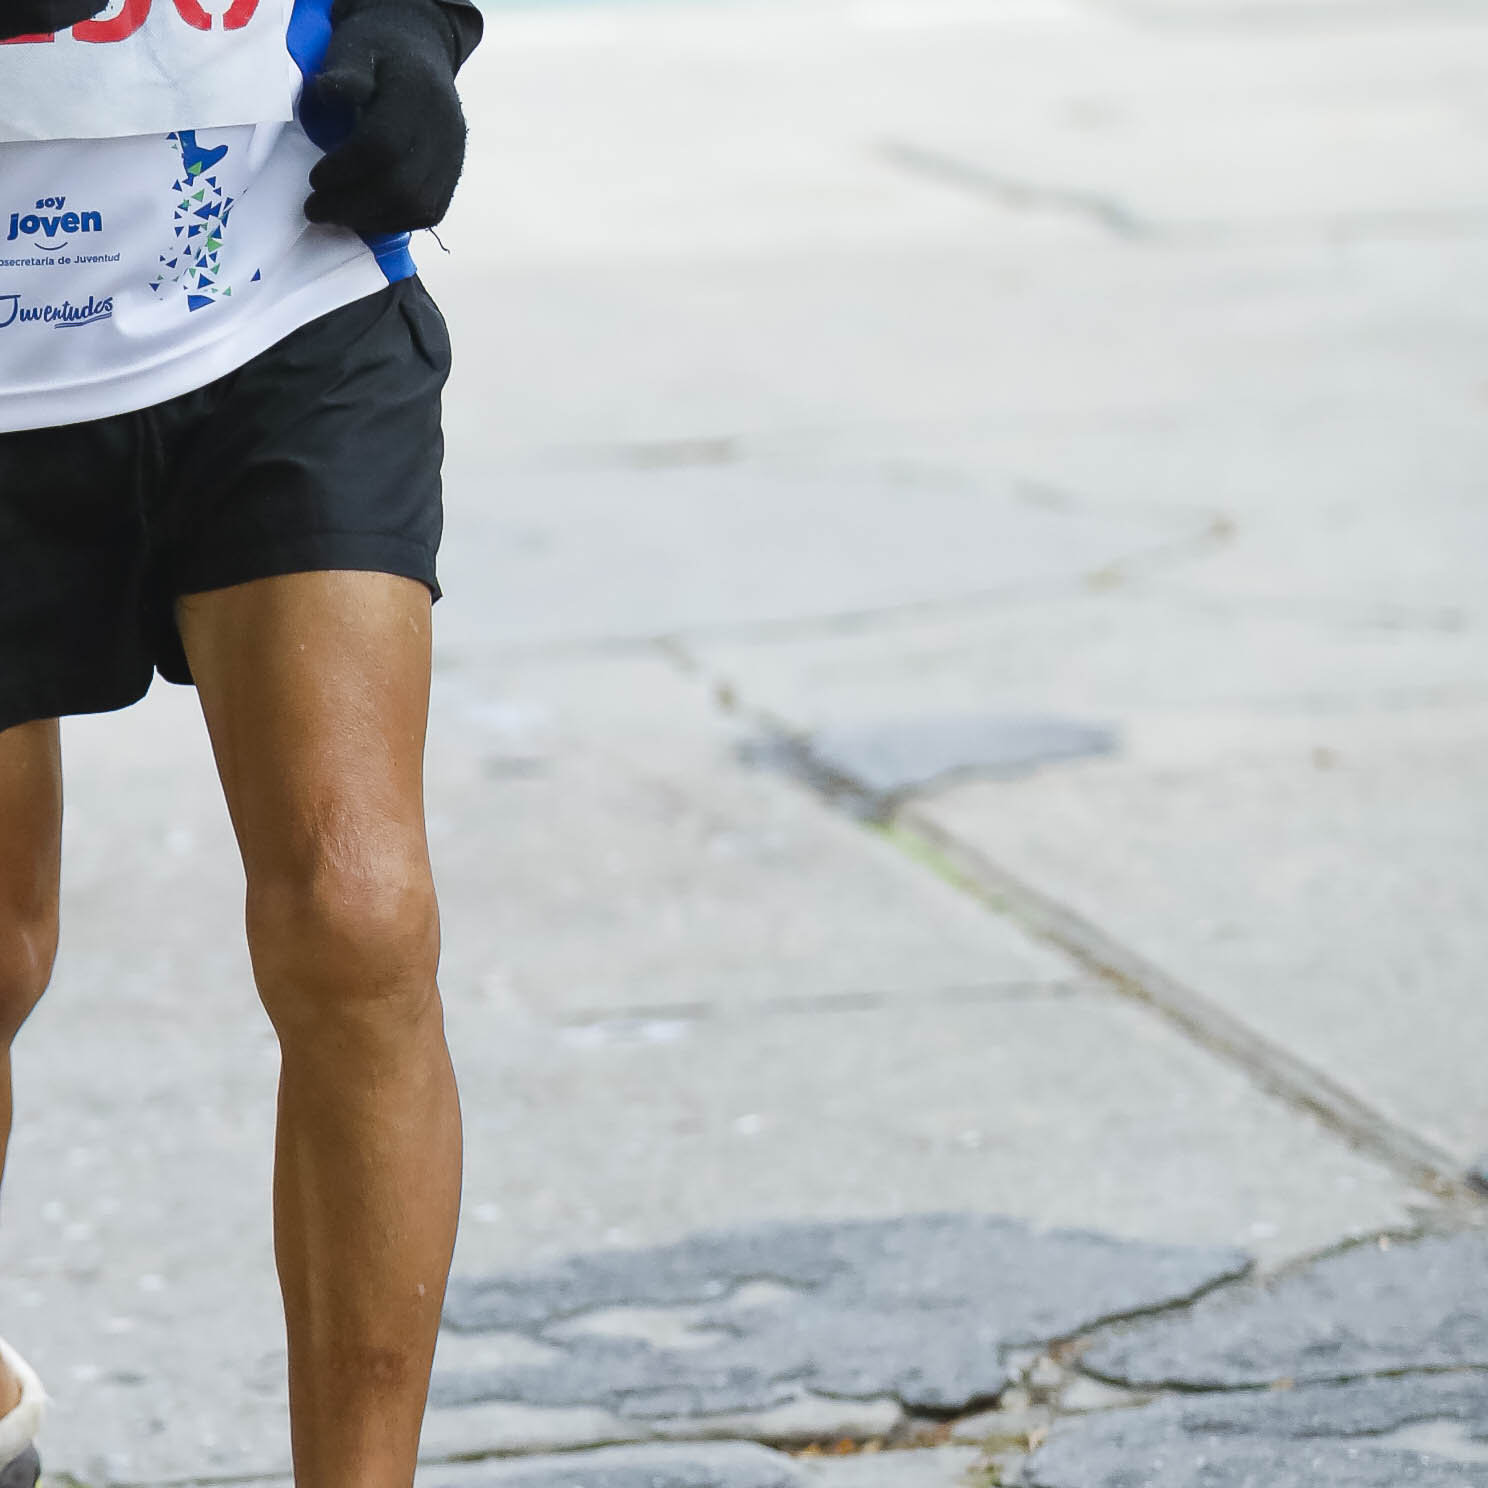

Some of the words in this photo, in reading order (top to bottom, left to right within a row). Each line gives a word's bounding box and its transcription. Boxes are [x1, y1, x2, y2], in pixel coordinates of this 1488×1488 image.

[35, 196, 66, 210] soy
[6, 210, 103, 241] joven
[57, 256, 71, 265] de
[74, 253, 121, 264] Juventud
